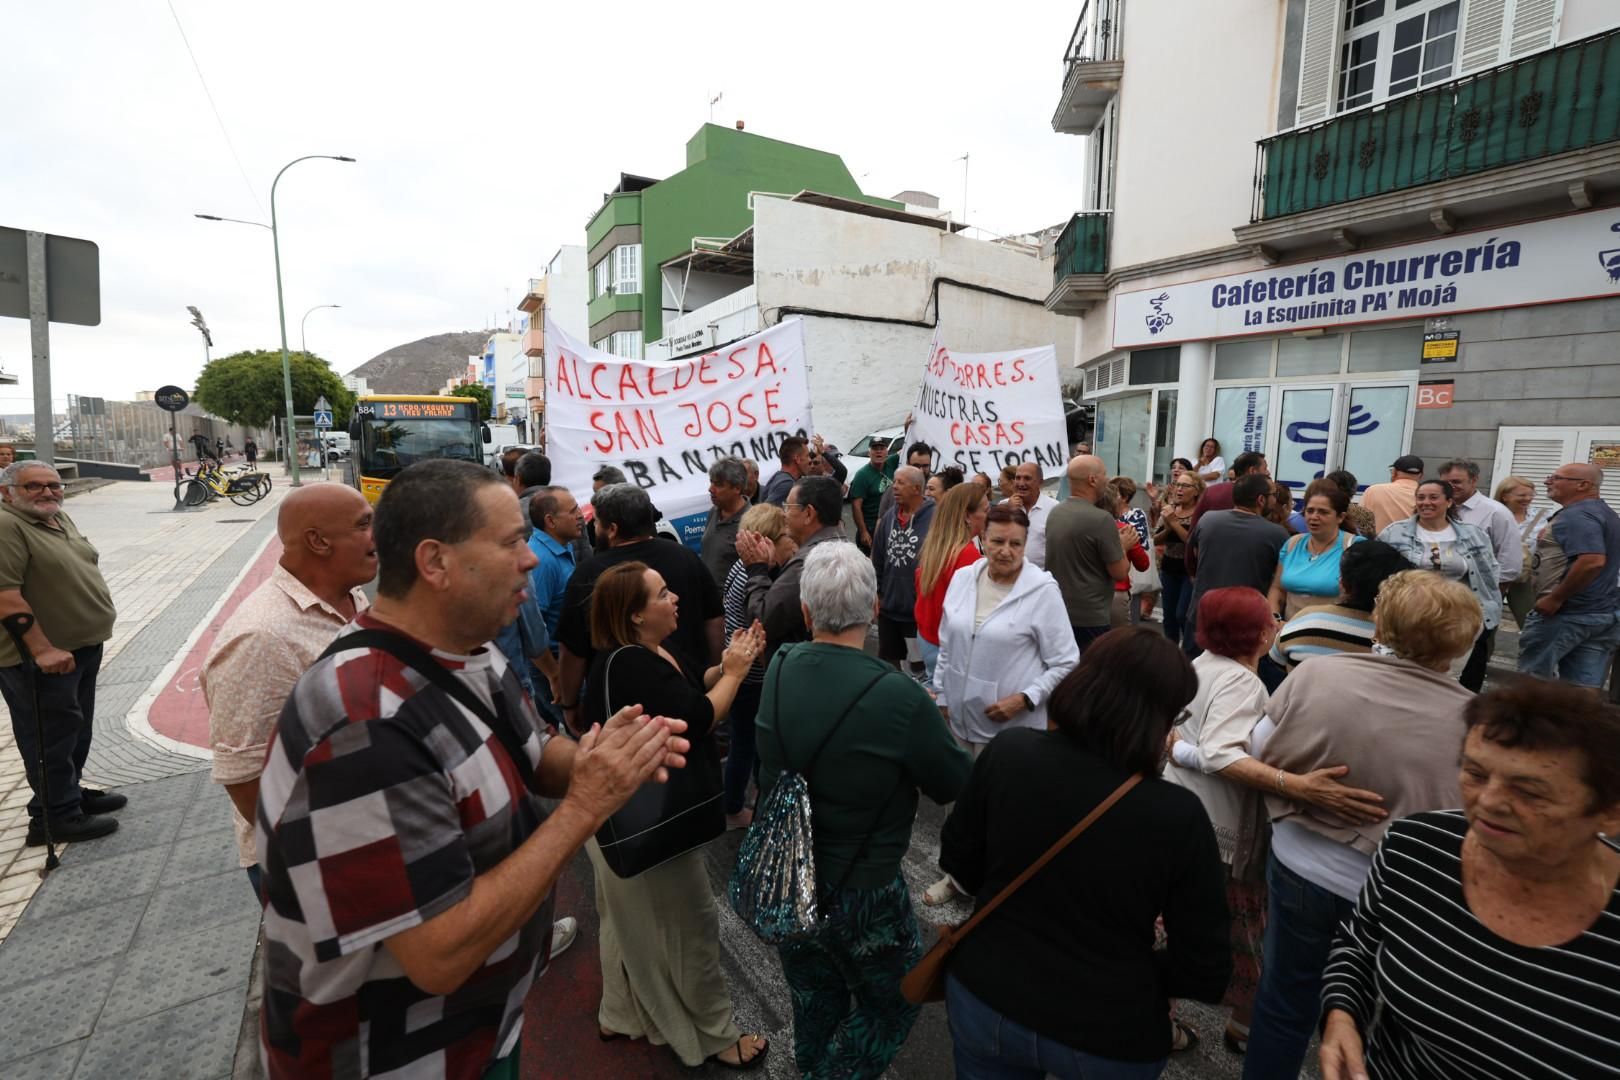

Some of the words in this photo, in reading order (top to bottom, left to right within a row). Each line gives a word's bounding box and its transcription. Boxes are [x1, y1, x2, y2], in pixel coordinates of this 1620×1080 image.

[1212, 268, 1335, 308] Cafetería
[1344, 237, 1521, 291] Churrería
[1244, 310, 1263, 326] La
[1266, 298, 1357, 324] Esquinita
[1397, 282, 1457, 309] Mojá
[383, 404, 398, 417] 13
[920, 382, 999, 424] NUESTRAS
[1418, 388, 1449, 405] Bc
[950, 421, 1025, 446] CASAS
